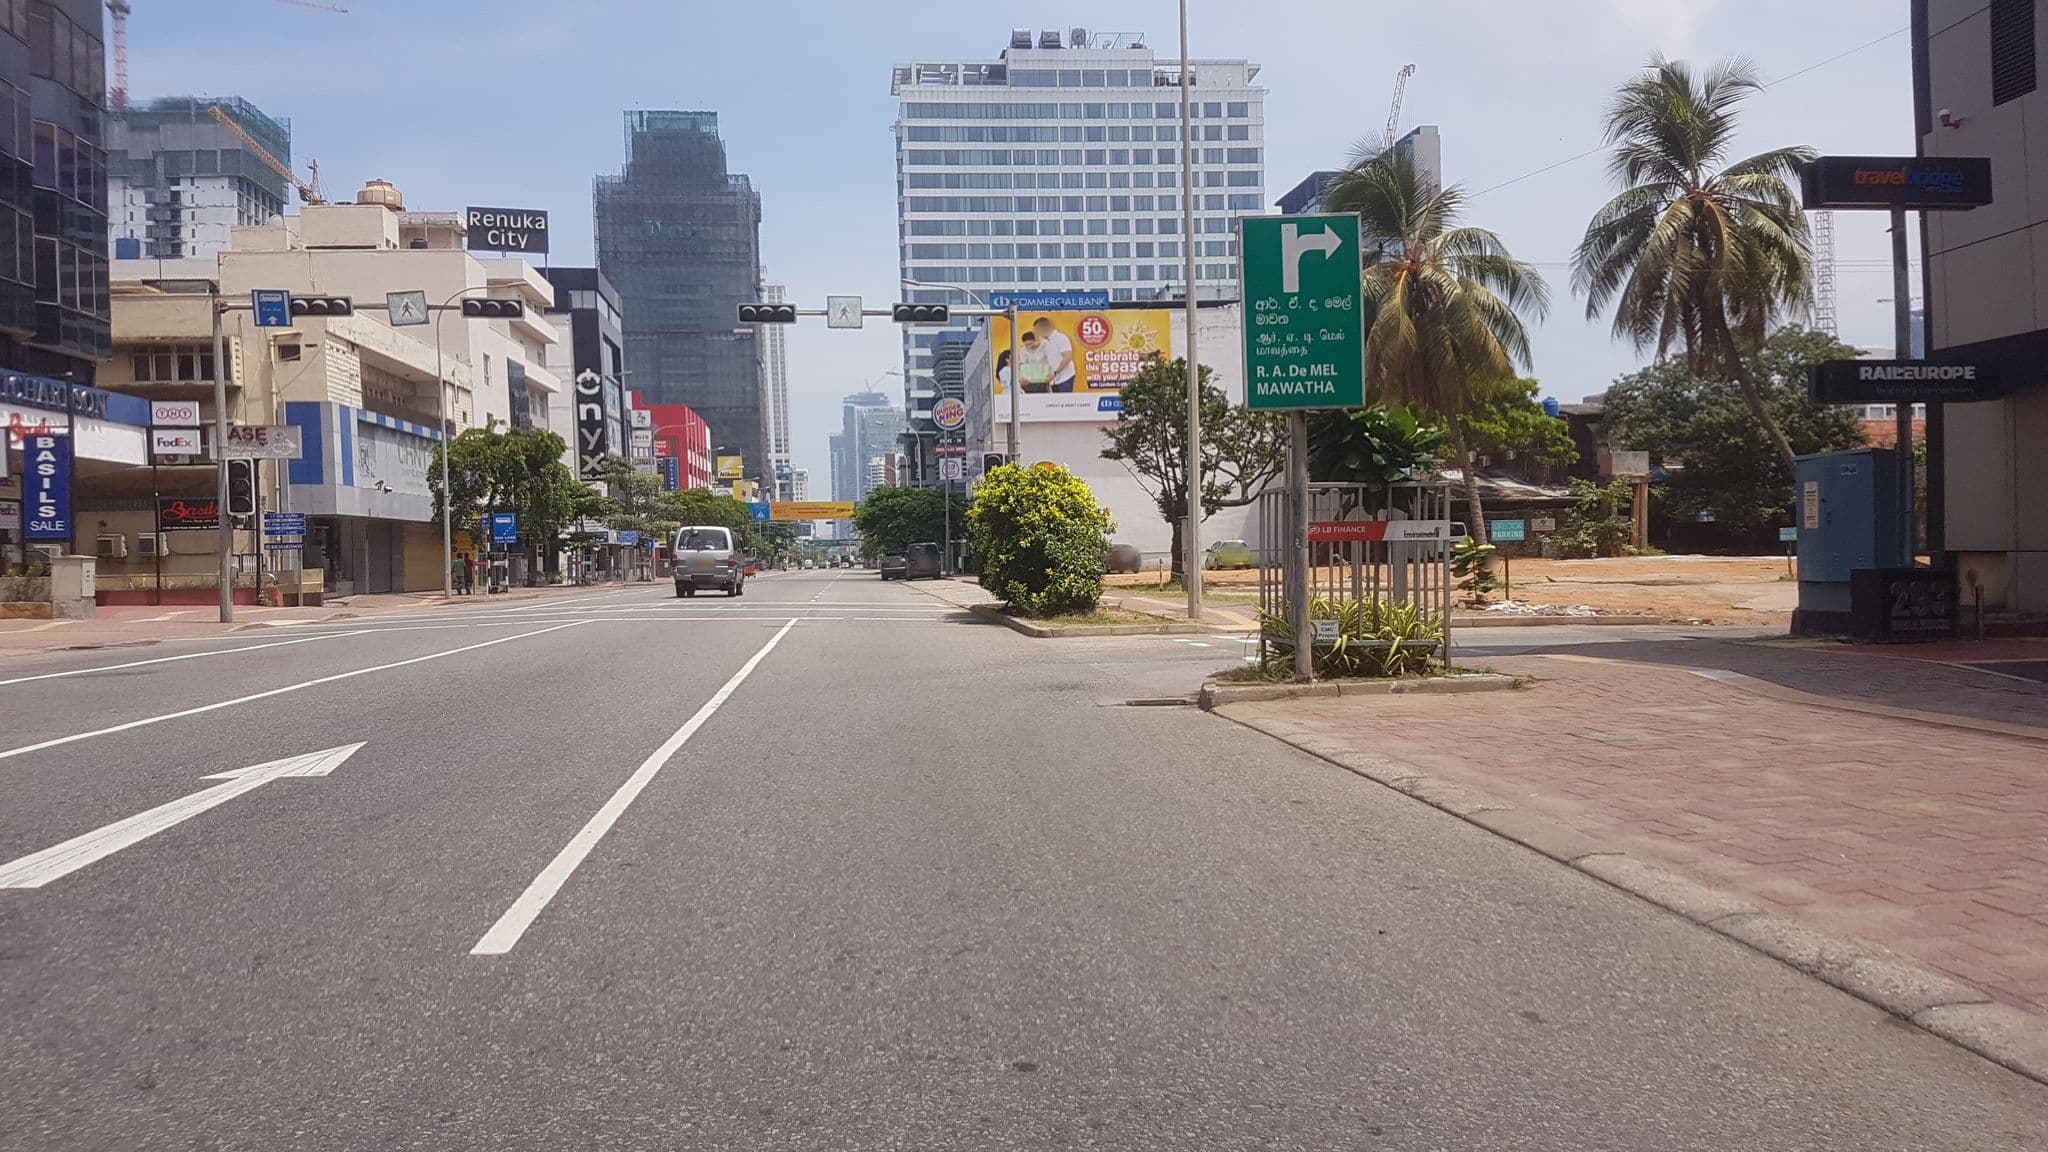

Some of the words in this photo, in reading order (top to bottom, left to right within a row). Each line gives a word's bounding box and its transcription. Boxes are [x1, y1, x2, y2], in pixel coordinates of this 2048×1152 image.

[469, 211, 545, 230] Renuka
[487, 229, 528, 249] City
[1013, 297, 1077, 307] COMMERCIAL
[1078, 296, 1105, 307] BANK
[1085, 350, 1140, 361] Celebrate
[1085, 363, 1099, 371] this
[1256, 365, 1269, 378] R.
[1272, 365, 1286, 377] A.
[1289, 364, 1307, 377] De
[1310, 363, 1338, 376] MEL
[1102, 374, 1118, 382] your
[1257, 380, 1336, 395] MAWATHA
[157, 408, 191, 419] TNT
[939, 408, 963, 422] KING
[227, 426, 267, 441] ASE
[157, 437, 192, 447] FedEx
[36, 436, 57, 518] BASILS
[30, 520, 65, 532] SALE
[1333, 525, 1366, 533] FINANCE
[1492, 530, 1523, 538] PARKING
